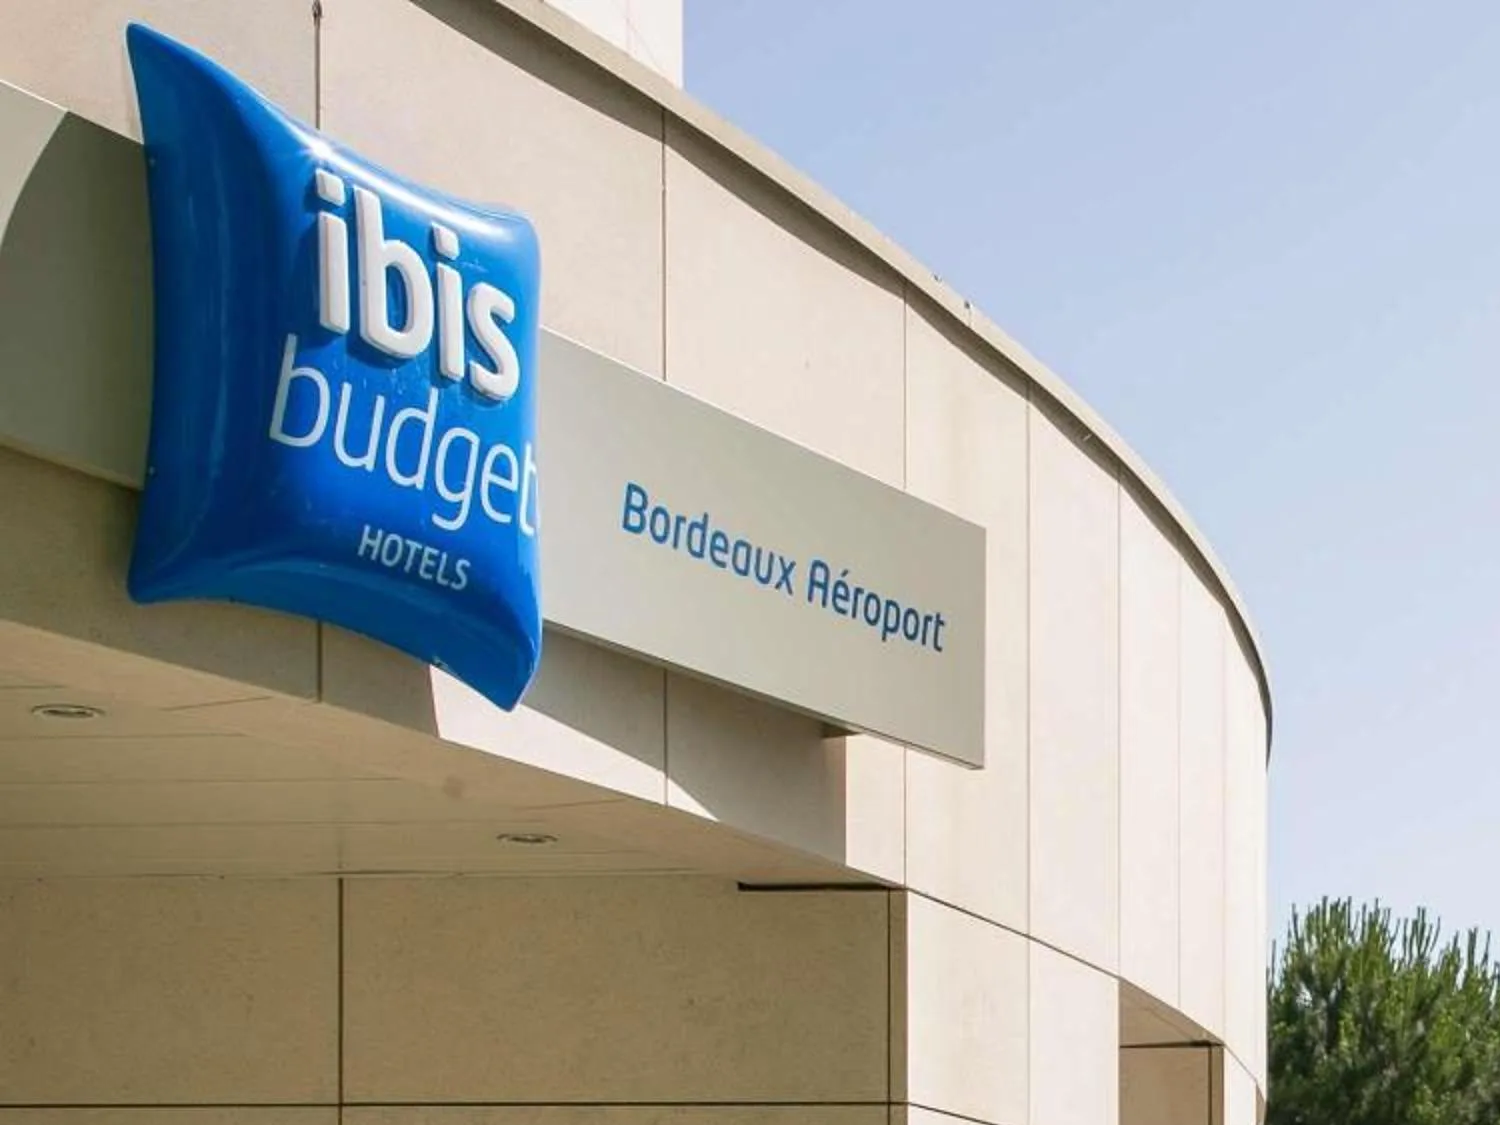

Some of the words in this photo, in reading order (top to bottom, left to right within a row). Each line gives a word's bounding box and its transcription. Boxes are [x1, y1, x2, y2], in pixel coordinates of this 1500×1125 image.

[315, 168, 520, 401] ibis
[357, 523, 471, 591] HOTELS
[622, 482, 797, 596] Bordeaux
[807, 559, 946, 653] Aéroport
